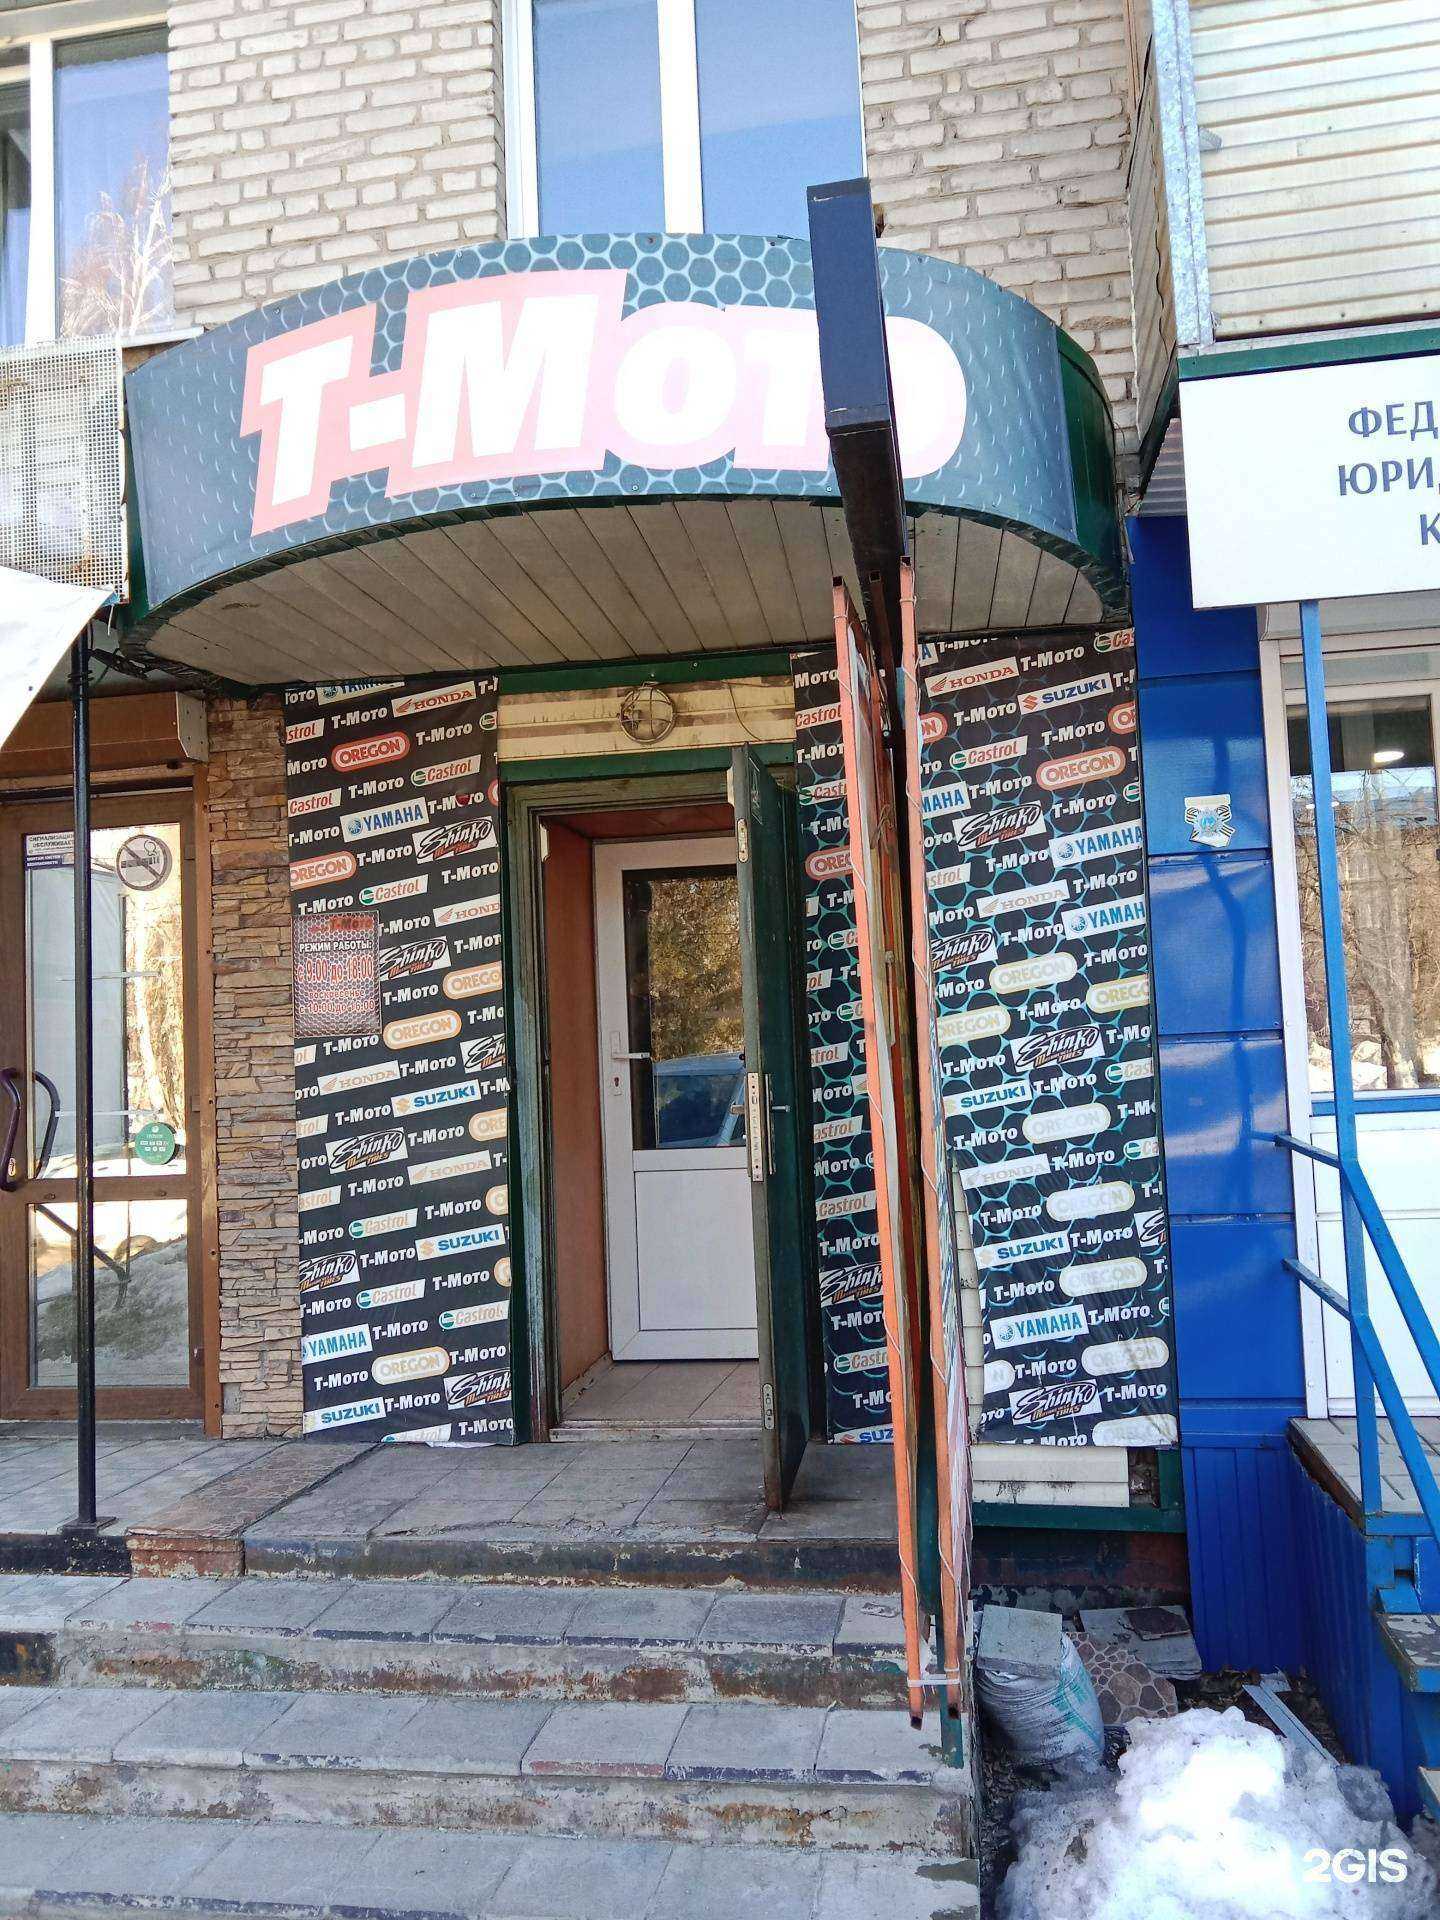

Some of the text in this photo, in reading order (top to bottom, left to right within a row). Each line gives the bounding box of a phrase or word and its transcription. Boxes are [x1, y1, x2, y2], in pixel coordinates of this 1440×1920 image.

[1338, 457, 1440, 496] ЮРИ
[1020, 646, 1084, 671] Т-Мото
[949, 666, 1015, 688] HONDA
[414, 689, 472, 710] HONDA
[1042, 679, 1106, 703] SUZUKI
[331, 707, 388, 729] Т-Мото
[954, 702, 1017, 726] Т-Мото
[416, 723, 473, 746] Т-Мото
[1041, 721, 1105, 746] Т-Мото
[339, 738, 400, 764] OREGON
[968, 742, 1018, 765] Castrol
[427, 760, 471, 781] Castrol
[1047, 752, 1115, 779] OREGON
[348, 777, 404, 799] Т-Мото
[968, 776, 1032, 799] Т-Мото
[290, 793, 333, 815] Castrol
[1052, 794, 1116, 818] Т-Мото
[364, 804, 423, 831] YAMAHA
[357, 845, 412, 866] Т-Мото
[986, 851, 1048, 872] Т-Мото
[291, 859, 348, 883] OREGON
[442, 862, 498, 884] Т-Мото
[1073, 870, 1137, 893] Т-Мото
[375, 881, 420, 901] Castrol
[1001, 889, 1065, 909] HONDA
[298, 895, 354, 915] Т-Мото
[1001, 924, 1064, 946] Т-Мото
[299, 940, 373, 953] РЕЖИМ РАБОТЫ:
[1084, 945, 1147, 967] Т-Мото
[999, 960, 1066, 985] OREGON
[383, 984, 438, 1005] Т-Мото
[1018, 999, 1080, 1020] Т-Мото
[392, 1018, 451, 1039] OREGON
[323, 1035, 379, 1056] Т-Мото
[400, 1056, 456, 1077] Т-Мото
[943, 1055, 1005, 1075] Т-Мото
[339, 1070, 396, 1088] HONDA
[1034, 1073, 1096, 1093] Т-Мото
[414, 1085, 475, 1107] SUZUKI
[961, 1085, 1026, 1108] SUZUKI
[335, 1104, 391, 1125] Т-Мото
[408, 1125, 464, 1147] Т-Мото
[954, 1127, 1017, 1150] Т-Мото
[430, 1160, 488, 1179] HONDA
[1053, 1150, 1115, 1170] Т-Мото
[348, 1175, 404, 1196] Т-Мото
[425, 1200, 482, 1220] Т-Мото
[818, 1196, 868, 1216] Castrol
[981, 1205, 1042, 1225] Т-Мото
[364, 1214, 408, 1234] Castrol
[438, 1229, 500, 1251] SUZUKI
[998, 1236, 1064, 1259] SUZUKI
[1070, 1227, 1133, 1248] Т-Мото
[360, 1248, 415, 1268] Т-Мото
[433, 1270, 490, 1290] Т-Мото
[994, 1280, 1054, 1300] Т-Мото
[372, 1284, 416, 1304] Castrol
[455, 1307, 504, 1325] Castrol
[1015, 1312, 1082, 1338] YAMAHA
[1088, 1305, 1151, 1324] Т-Мото
[372, 1320, 428, 1340] Т-Мото
[307, 1331, 367, 1356] YAMAHA
[381, 1354, 439, 1376] OREGON
[450, 1346, 506, 1365] Т-Мото
[1015, 1359, 1076, 1379] Т-Мото
[314, 1370, 369, 1391] Т-Мото
[385, 1393, 440, 1411] Т-Мото
[1106, 1384, 1167, 1402] Т-Мото
[321, 1402, 380, 1424] SUZUKI
